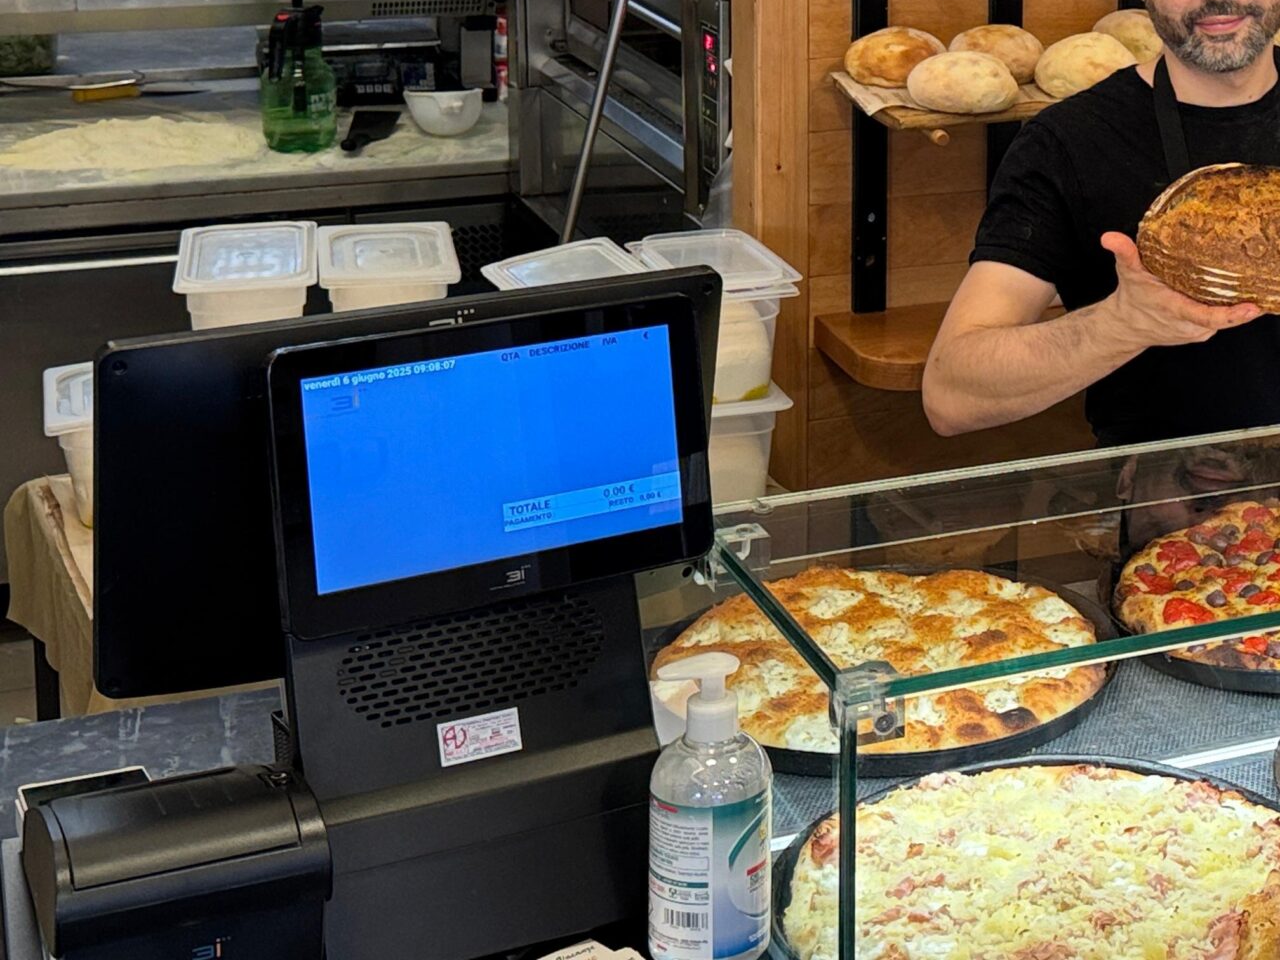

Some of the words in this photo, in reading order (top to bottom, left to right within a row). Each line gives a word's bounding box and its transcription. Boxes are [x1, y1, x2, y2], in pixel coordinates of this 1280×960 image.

[501, 351, 520, 362] QTA
[529, 340, 591, 358] DESCRIZIONE
[343, 375, 350, 385] 6
[351, 372, 386, 386] giugno
[387, 366, 412, 379] 2025
[509, 499, 551, 516] TOTALE
